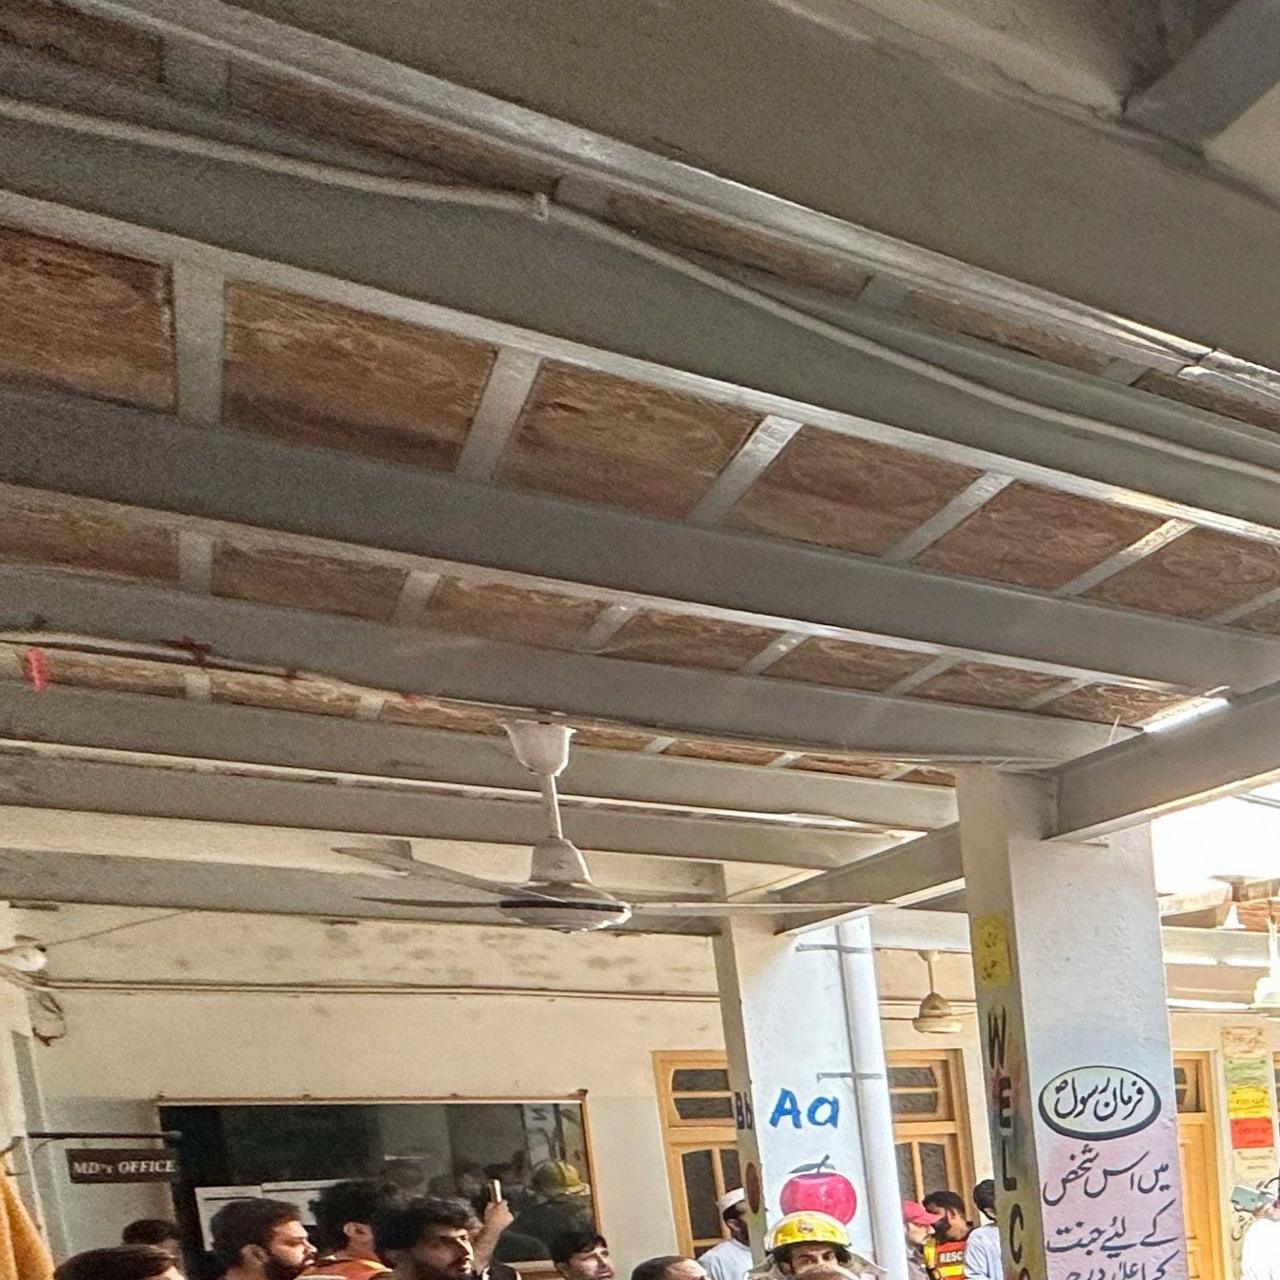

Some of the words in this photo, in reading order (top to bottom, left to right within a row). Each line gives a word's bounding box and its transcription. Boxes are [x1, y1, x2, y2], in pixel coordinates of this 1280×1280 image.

[768, 1087, 840, 1130] Aa
[1093, 1076, 1145, 1121] فرمان
[117, 1159, 176, 1174] OFFICE
[1042, 1142, 1100, 1207] شخص
[1083, 1150, 1150, 1199] اس
[1045, 1220, 1107, 1256] جنت
[1139, 1198, 1179, 1247] کے
